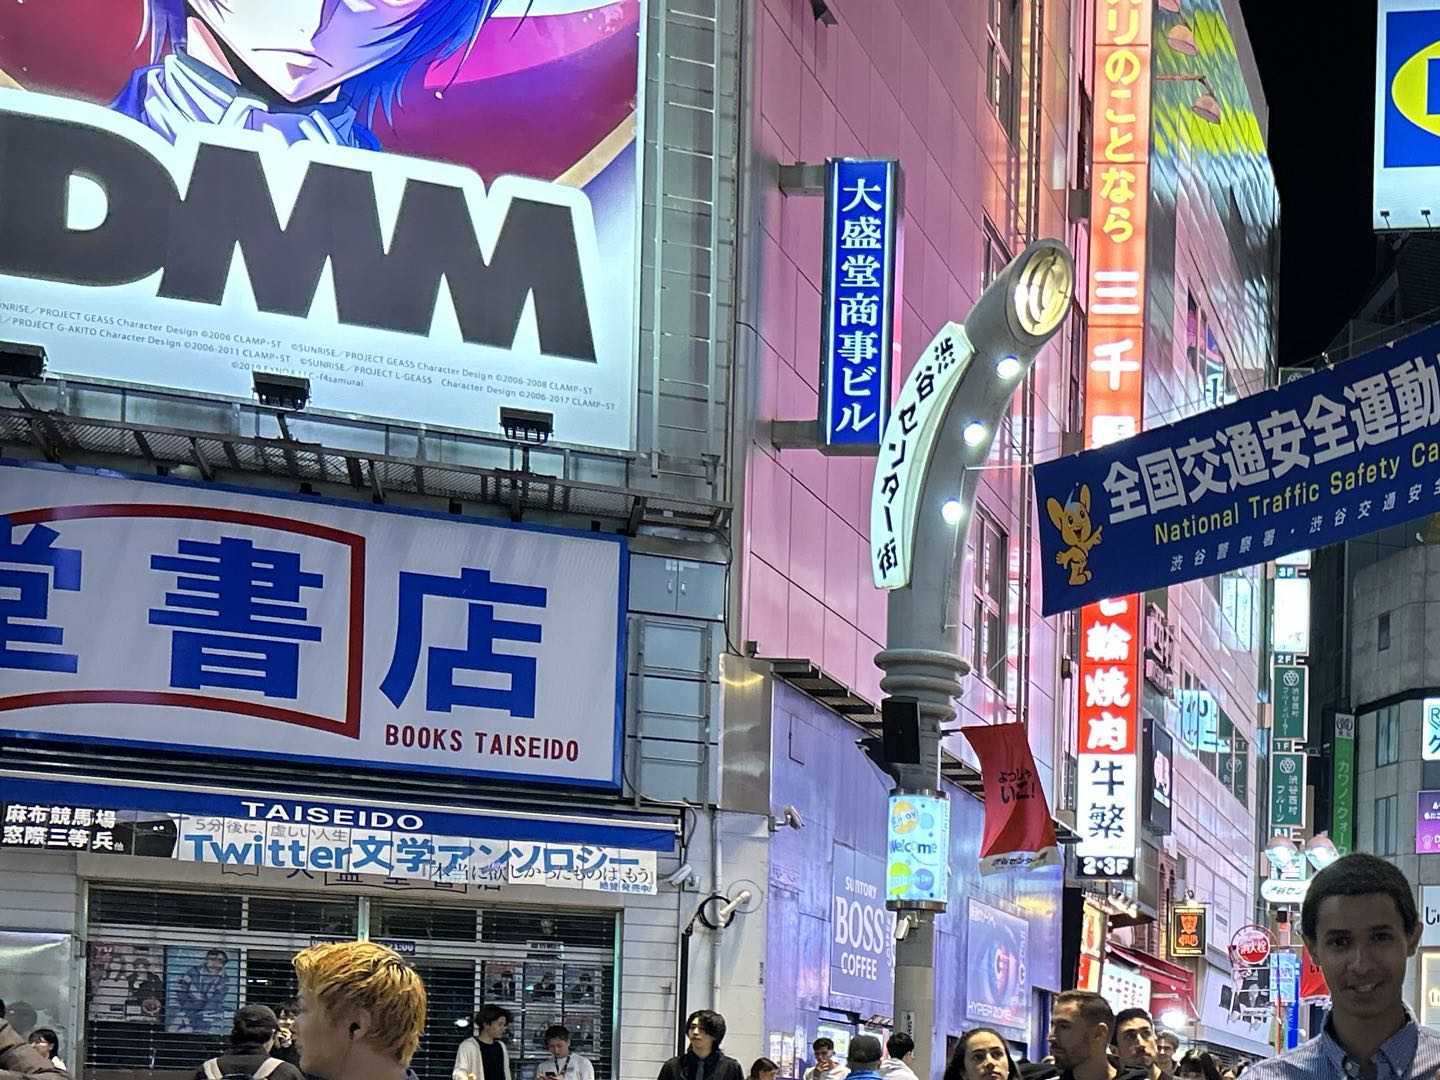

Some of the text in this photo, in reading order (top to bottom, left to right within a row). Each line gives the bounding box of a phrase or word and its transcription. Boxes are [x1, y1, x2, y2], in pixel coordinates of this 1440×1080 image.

[1100, 0, 1141, 243] リのことなら
[0, 108, 597, 363] DMM
[836, 178, 882, 434] 大盛堂商事ビル
[57, 323, 97, 336] G-AKITO
[99, 329, 145, 343] Character
[147, 335, 181, 348] Design
[84, 312, 115, 325] GEASS
[117, 318, 163, 332] Character
[166, 325, 199, 338] Design
[386, 357, 416, 369] GEASS
[416, 361, 460, 377] Character
[461, 369, 493, 382] Design
[441, 379, 483, 392] Character
[486, 385, 516, 398] Design
[877, 336, 955, 579] 渋谷センター街
[1154, 502, 1239, 545] National
[1248, 481, 1320, 519] Traffic
[1330, 456, 1400, 495] Safety
[1279, 568, 1293, 576] 3F
[1277, 655, 1291, 664] 2F
[385, 724, 579, 762] BOOKS TAISEIDO
[1275, 742, 1288, 750] 1F
[1088, 760, 1125, 839] 牛繁
[5, 804, 117, 829] 麻布競馬場
[241, 801, 424, 830] TAISEIDO
[184, 834, 640, 873] Twitter文学アンソロジー
[835, 897, 884, 954] BOSS
[841, 952, 877, 980] COFFEE
